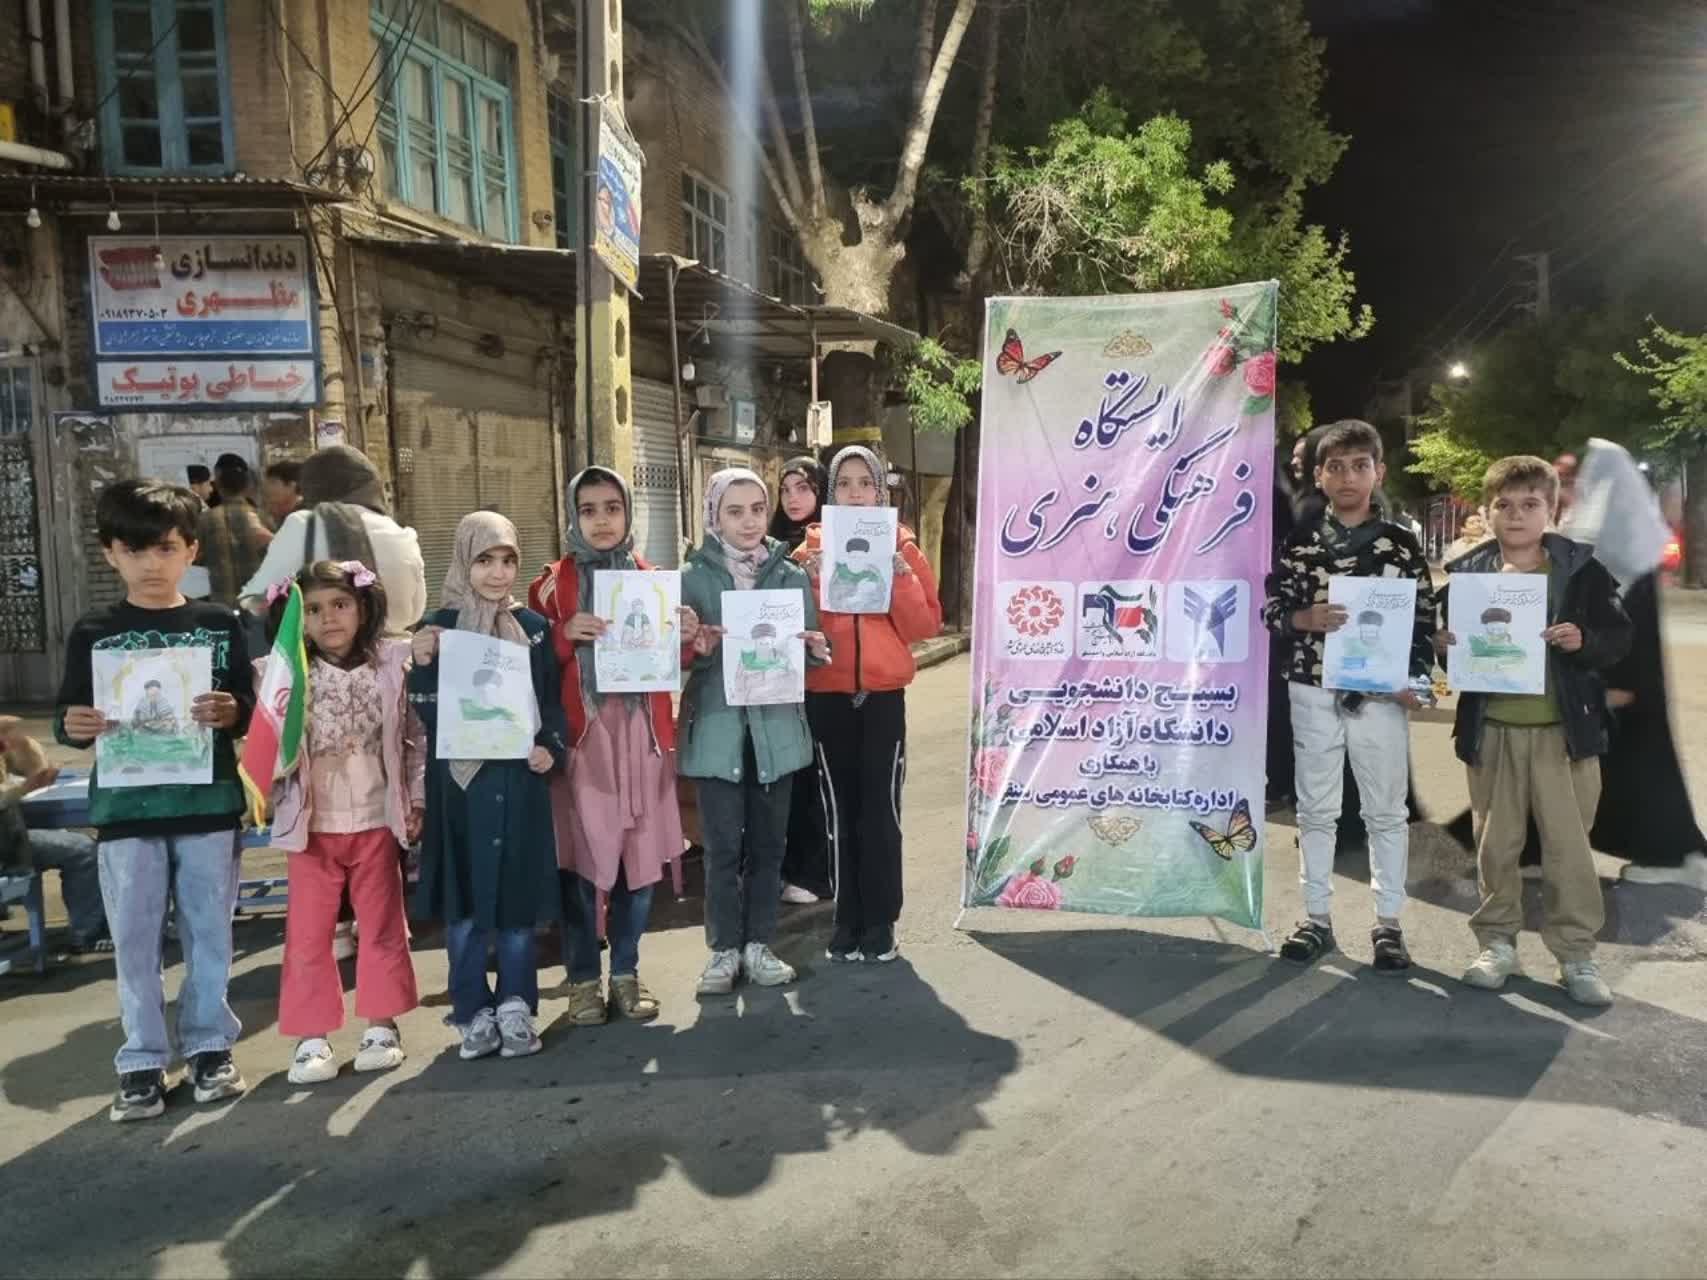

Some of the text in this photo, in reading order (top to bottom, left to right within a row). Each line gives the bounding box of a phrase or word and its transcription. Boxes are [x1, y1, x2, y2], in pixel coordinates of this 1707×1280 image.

[171, 244, 297, 280] دندانسازی
[176, 280, 298, 317] مظهری
[112, 364, 304, 400] خیاطی بوتیک
[1074, 370, 1183, 447] ایستگاه
[1127, 424, 1255, 554] فرهنگی
[1000, 473, 1117, 555] هنری
[1008, 677, 1237, 710] بسیج دانشجویی
[1008, 710, 1232, 746] دانشگاه آزاد اسلامی
[1079, 753, 1158, 776] با همکاری
[1035, 786, 1089, 806] عمومی
[1193, 790, 1235, 812] اداره
